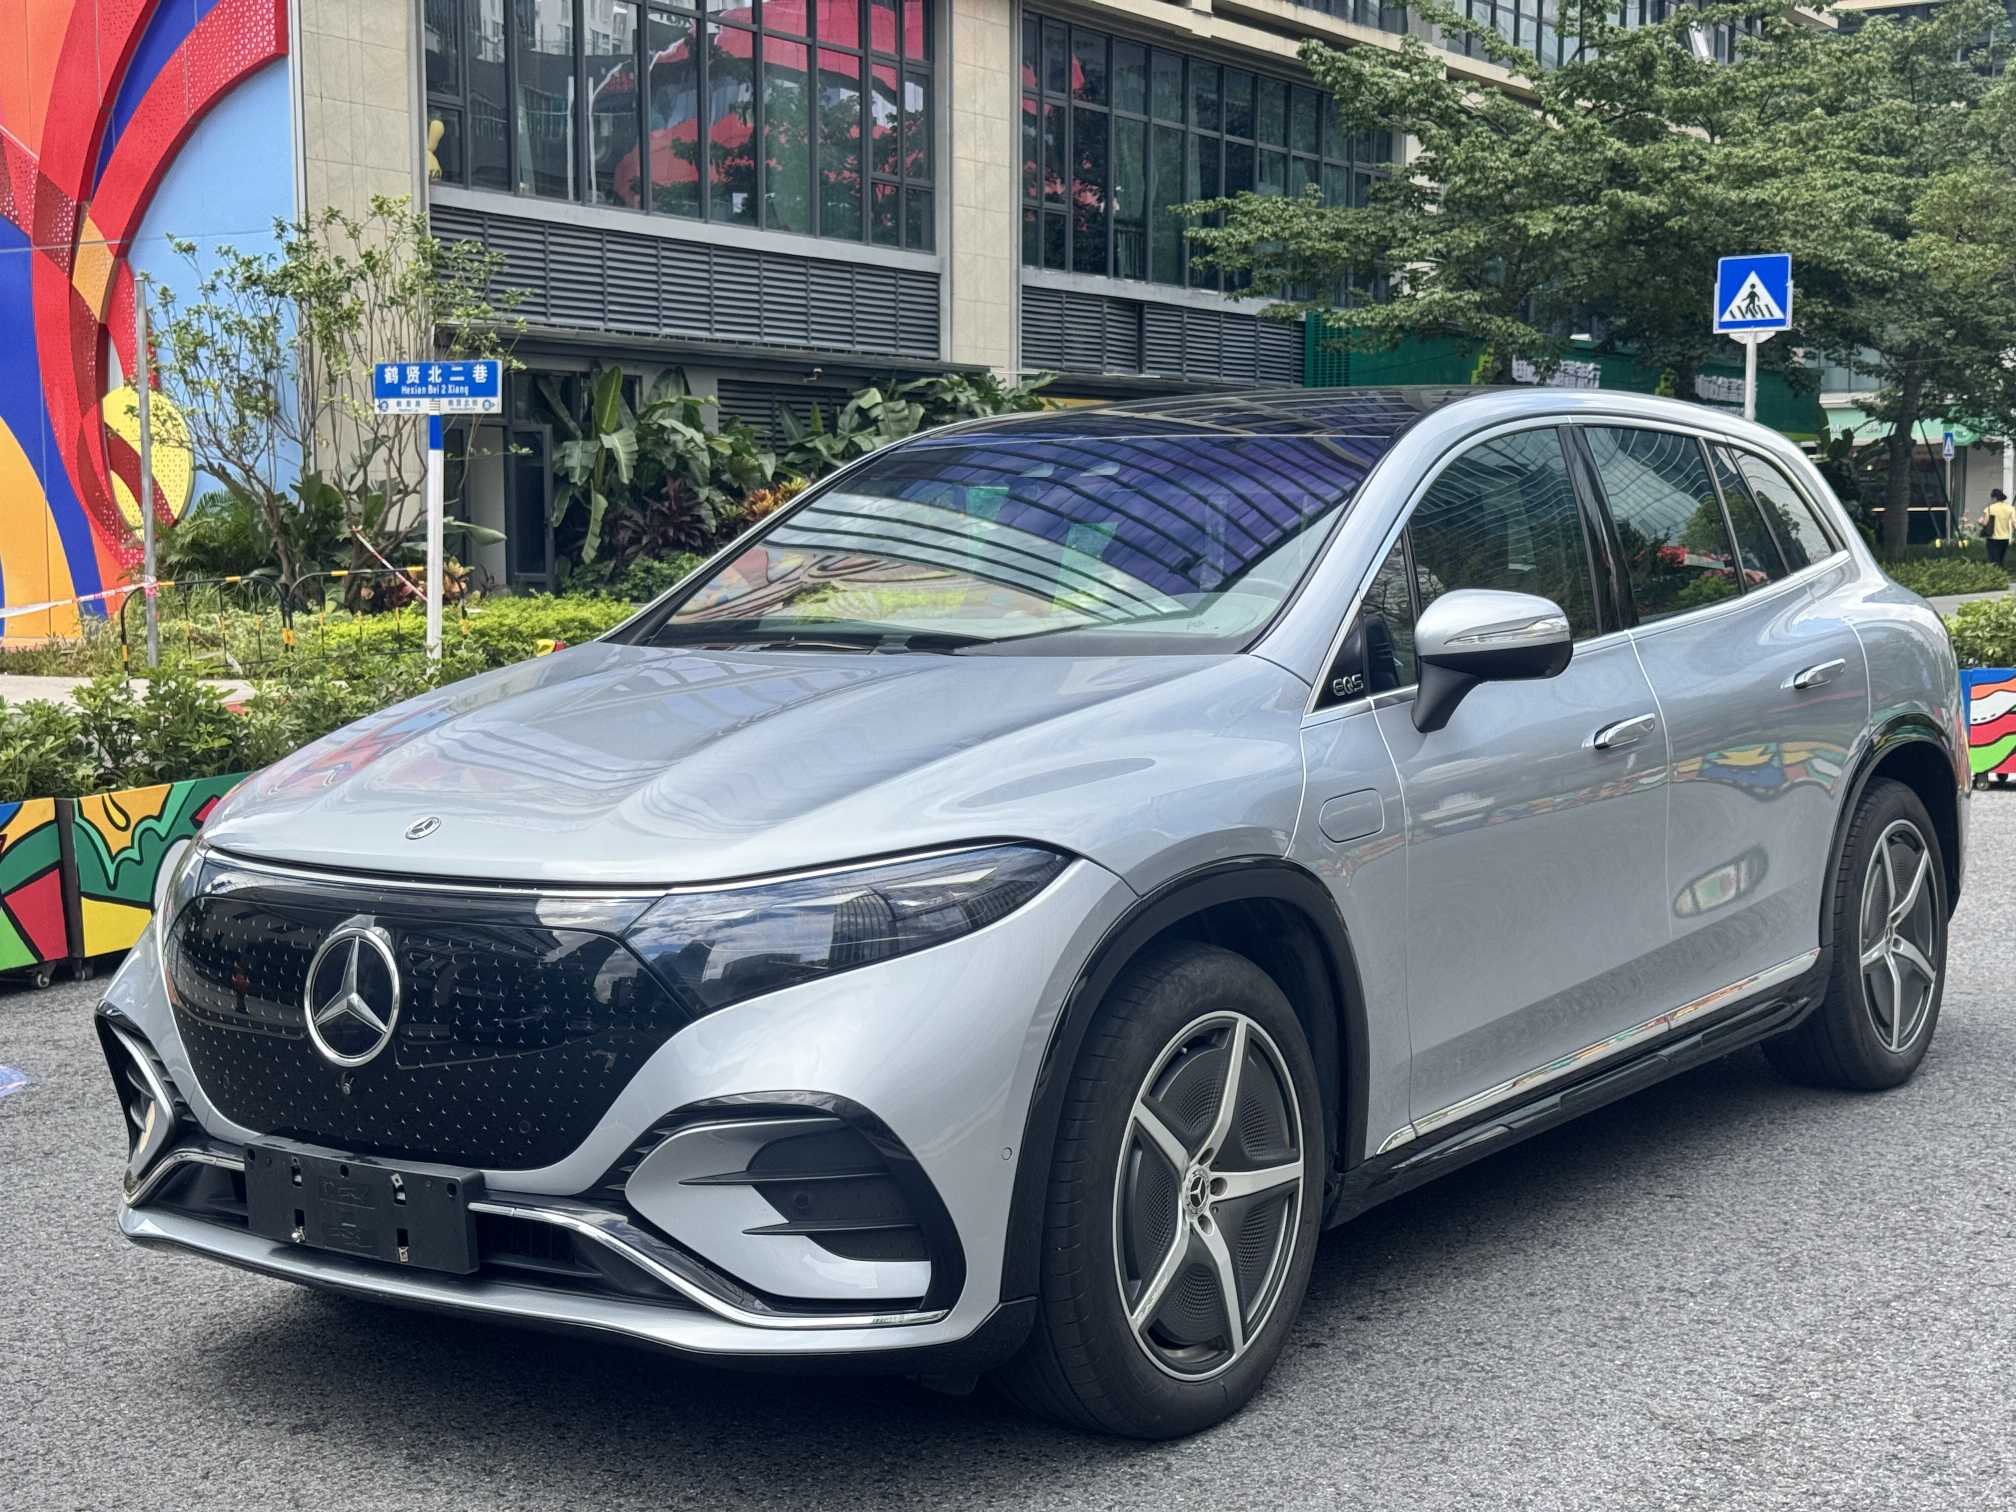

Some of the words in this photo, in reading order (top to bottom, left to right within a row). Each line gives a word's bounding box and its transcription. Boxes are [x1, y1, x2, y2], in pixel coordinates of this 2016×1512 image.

[384, 364, 489, 384] 鹤贤北二巷
[401, 385, 426, 395] Hexian
[428, 384, 440, 394] Bei
[441, 385, 447, 394] 2
[448, 384, 469, 395] Xiang
[1333, 673, 1364, 697] EQS
